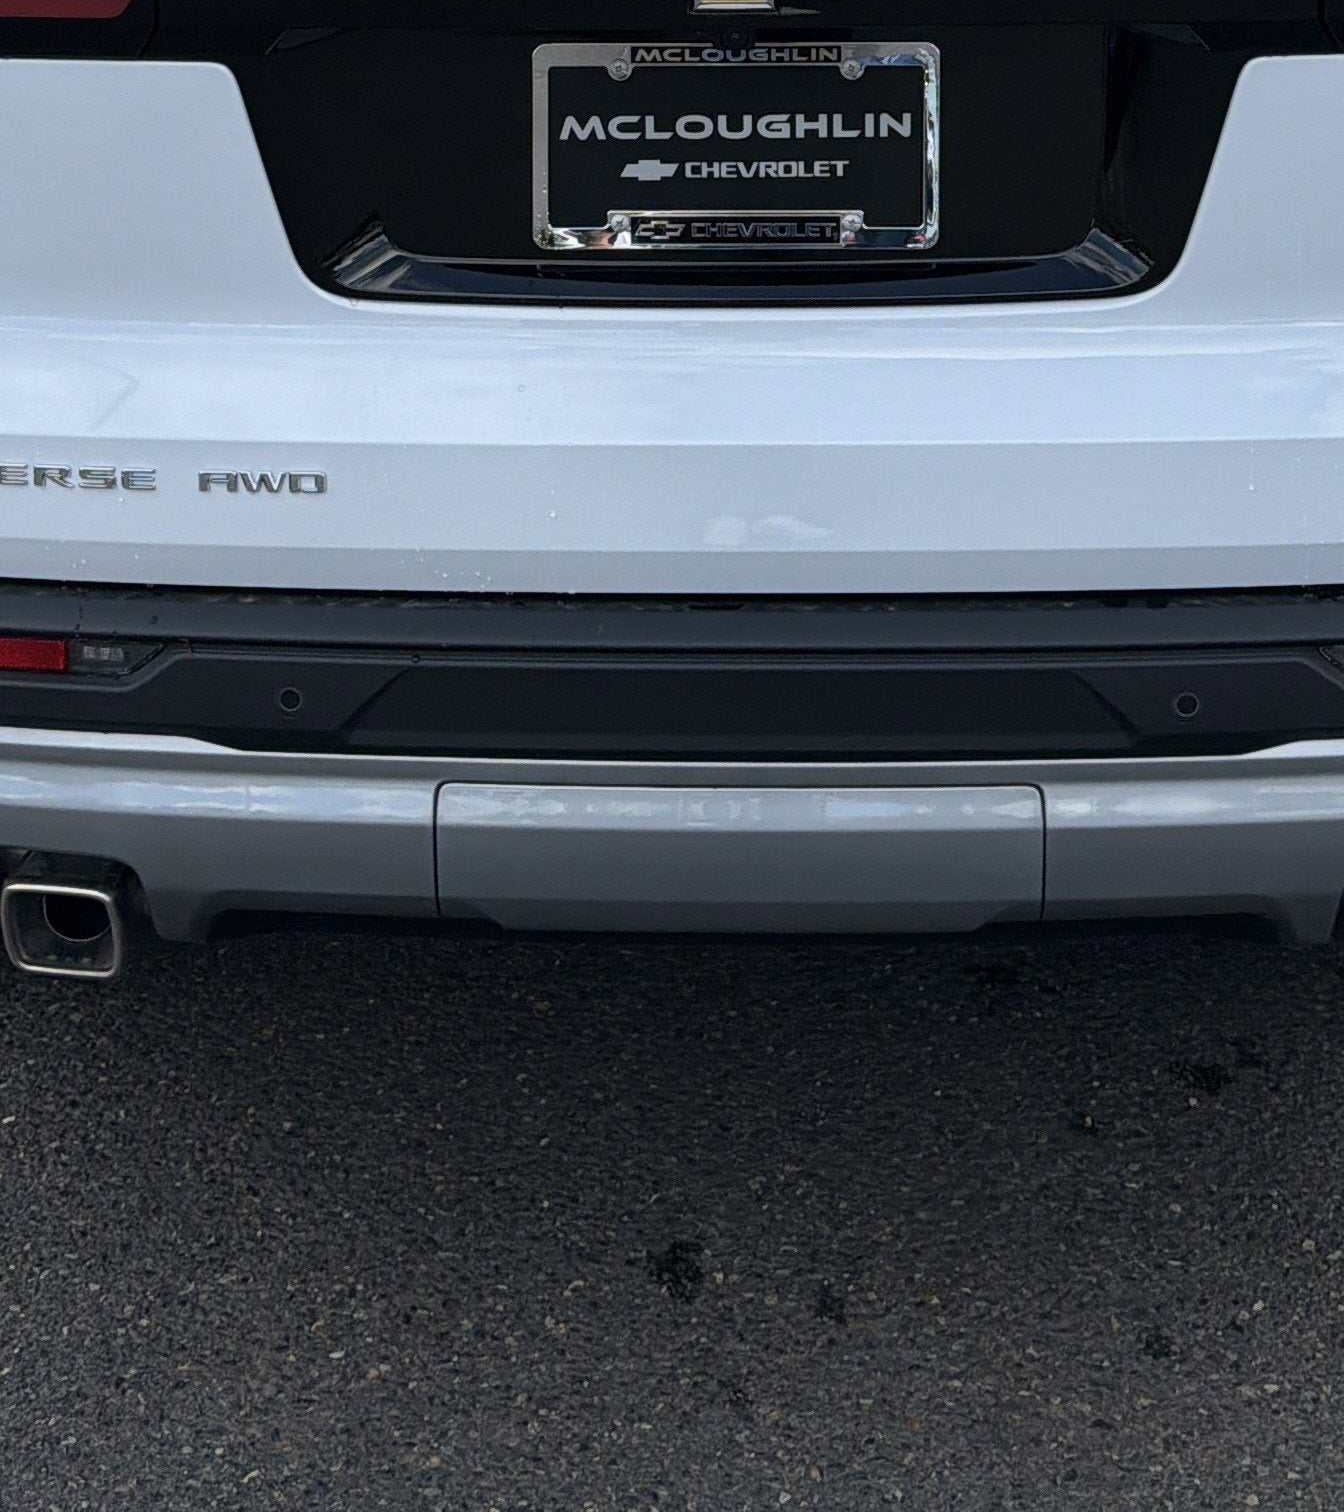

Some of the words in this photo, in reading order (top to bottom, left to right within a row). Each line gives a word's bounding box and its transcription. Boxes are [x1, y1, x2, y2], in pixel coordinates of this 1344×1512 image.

[634, 47, 839, 63] MCLOUGHLIN
[558, 111, 912, 141] MCLOUGHLIN
[684, 159, 850, 179] CHEVROLET
[691, 221, 837, 238] CHEVROLET
[197, 468, 328, 494] AWD
